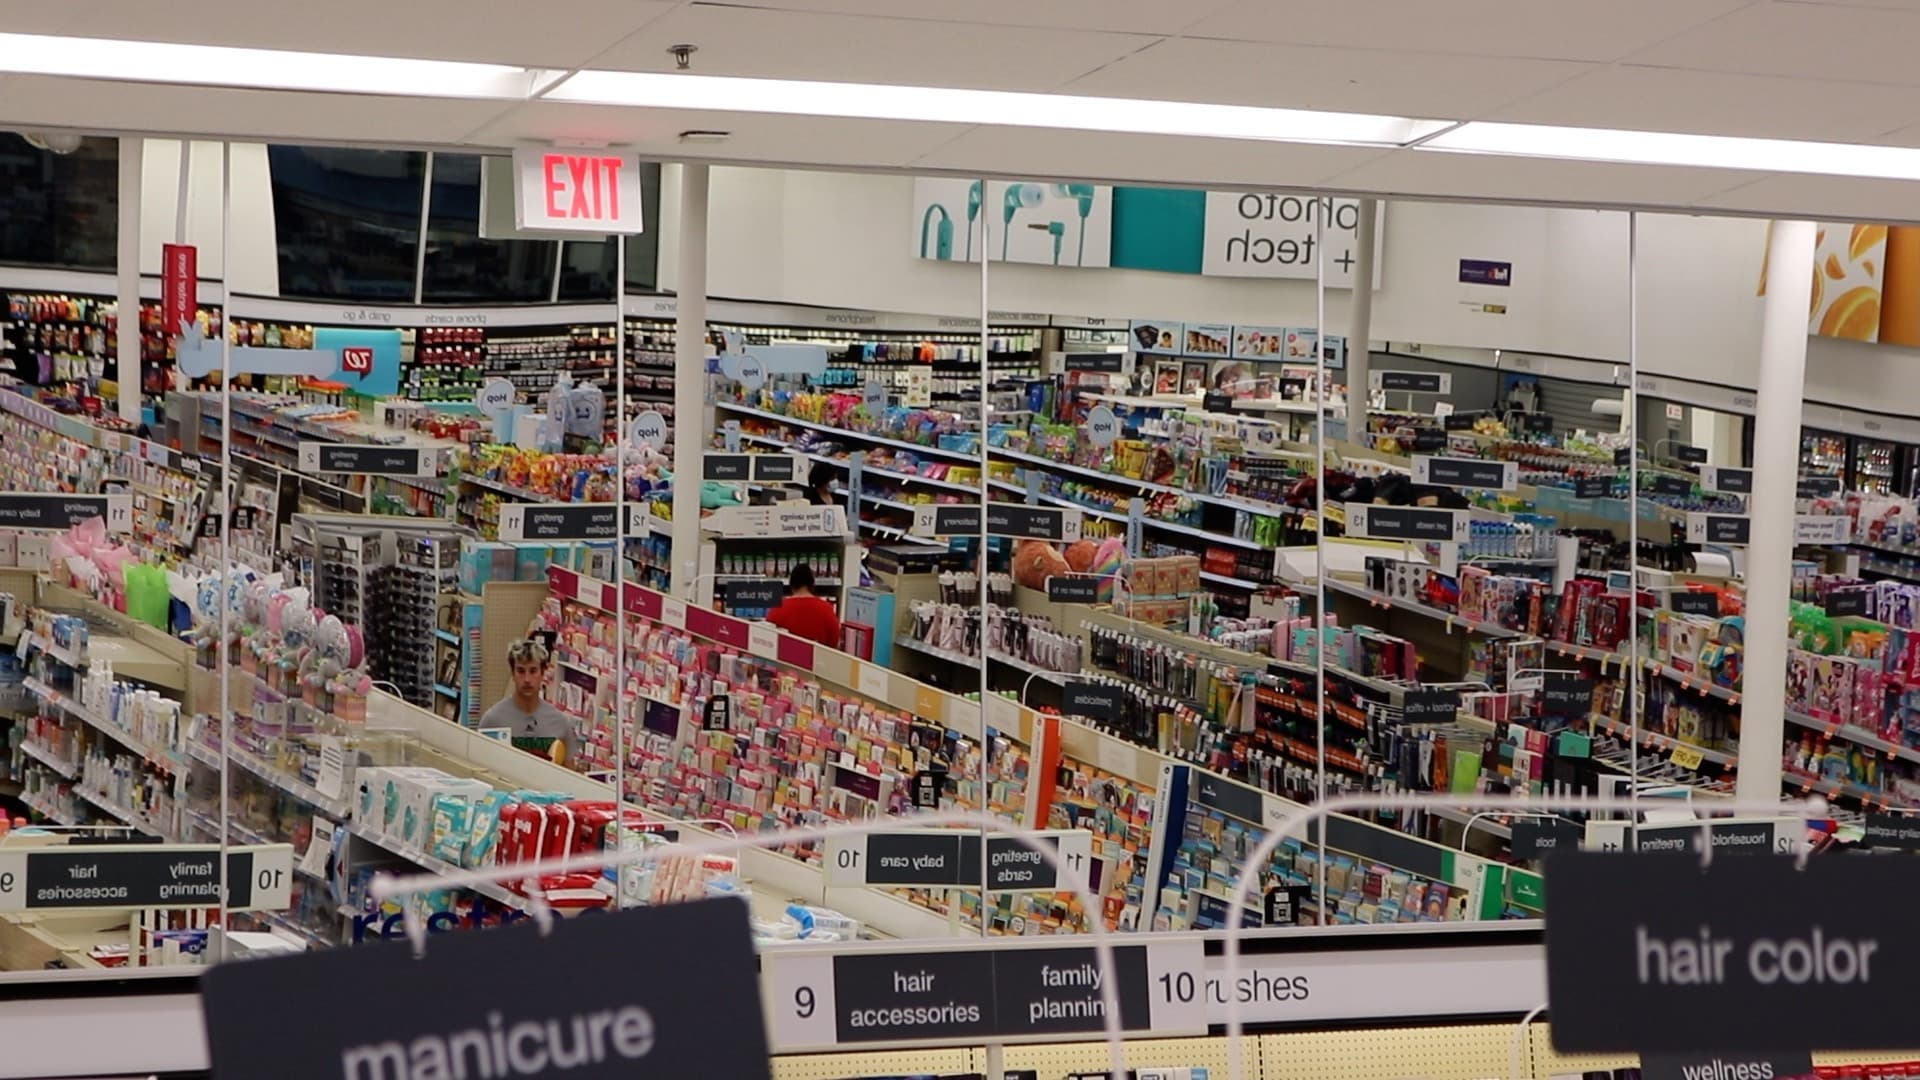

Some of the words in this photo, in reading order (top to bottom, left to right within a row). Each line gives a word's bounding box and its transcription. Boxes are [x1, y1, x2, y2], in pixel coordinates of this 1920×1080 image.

[543, 155, 622, 220] EXIT
[1636, 924, 1734, 985] hair
[1748, 925, 1878, 985] color
[894, 970, 936, 993] hair
[1041, 964, 1104, 991] family
[1157, 970, 1195, 1004] 10
[795, 985, 818, 1019] 9
[851, 1002, 981, 1028] accessories
[342, 1004, 656, 1080] manicure
[1682, 1059, 1775, 1080] wellness
